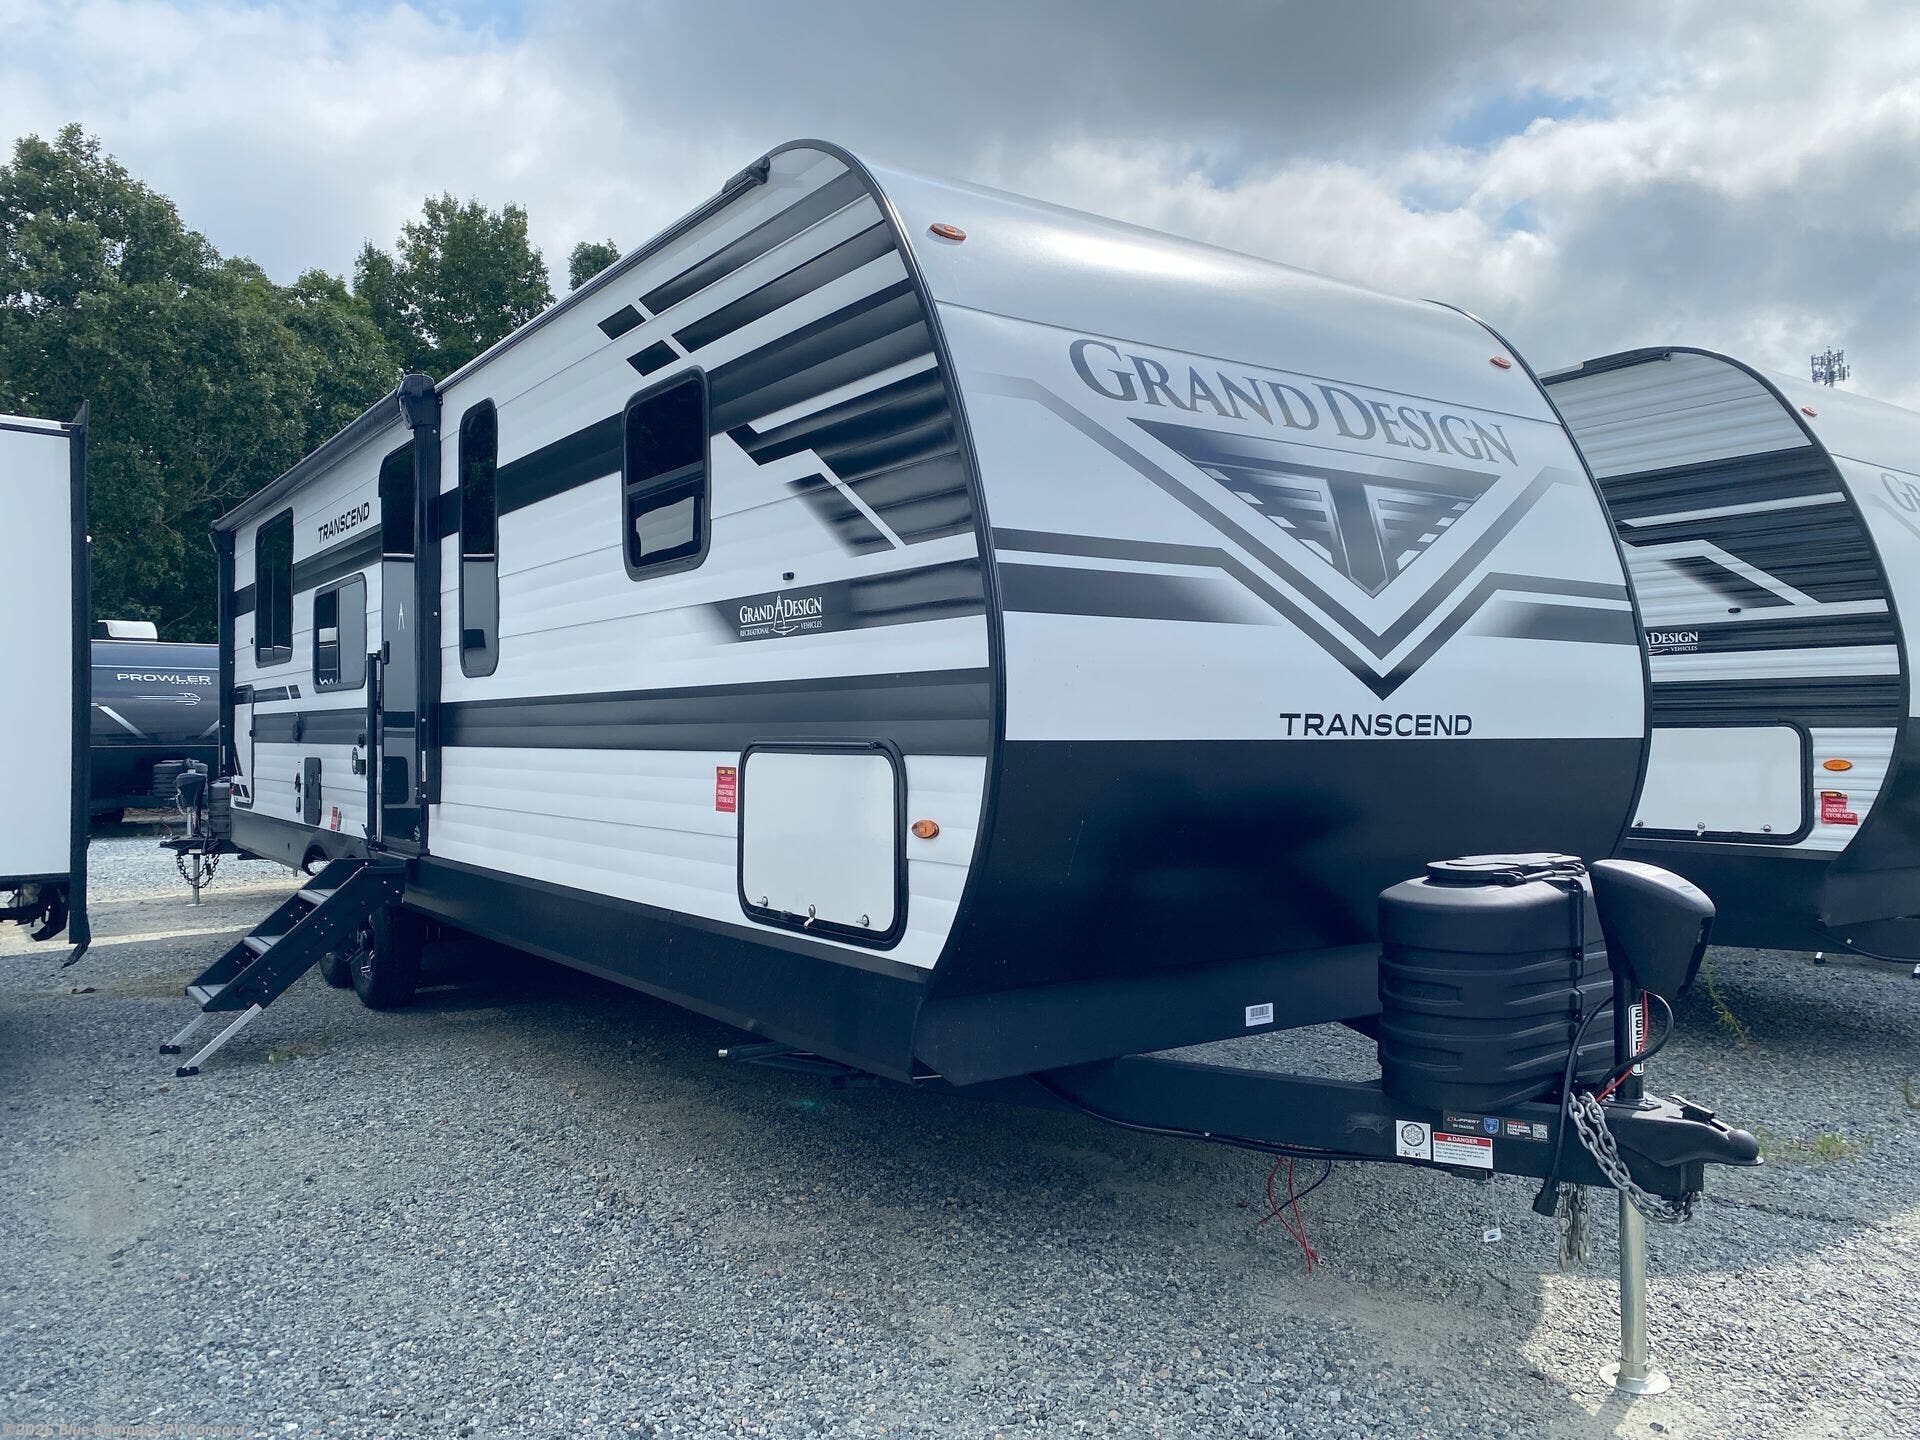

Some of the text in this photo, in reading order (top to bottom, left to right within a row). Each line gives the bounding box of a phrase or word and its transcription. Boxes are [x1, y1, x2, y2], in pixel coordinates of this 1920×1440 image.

[1068, 338, 1519, 467] GRAND DESIGN
[318, 501, 370, 544] TRANSCEND
[739, 596, 822, 623] GRAND DESIGN
[800, 620, 822, 630] VEHICLES
[1650, 631, 1698, 644] DESIGN
[116, 673, 211, 683] PROWLER
[1279, 712, 1473, 736] TRANSCEND
[1452, 1137, 1478, 1145] DANGER
